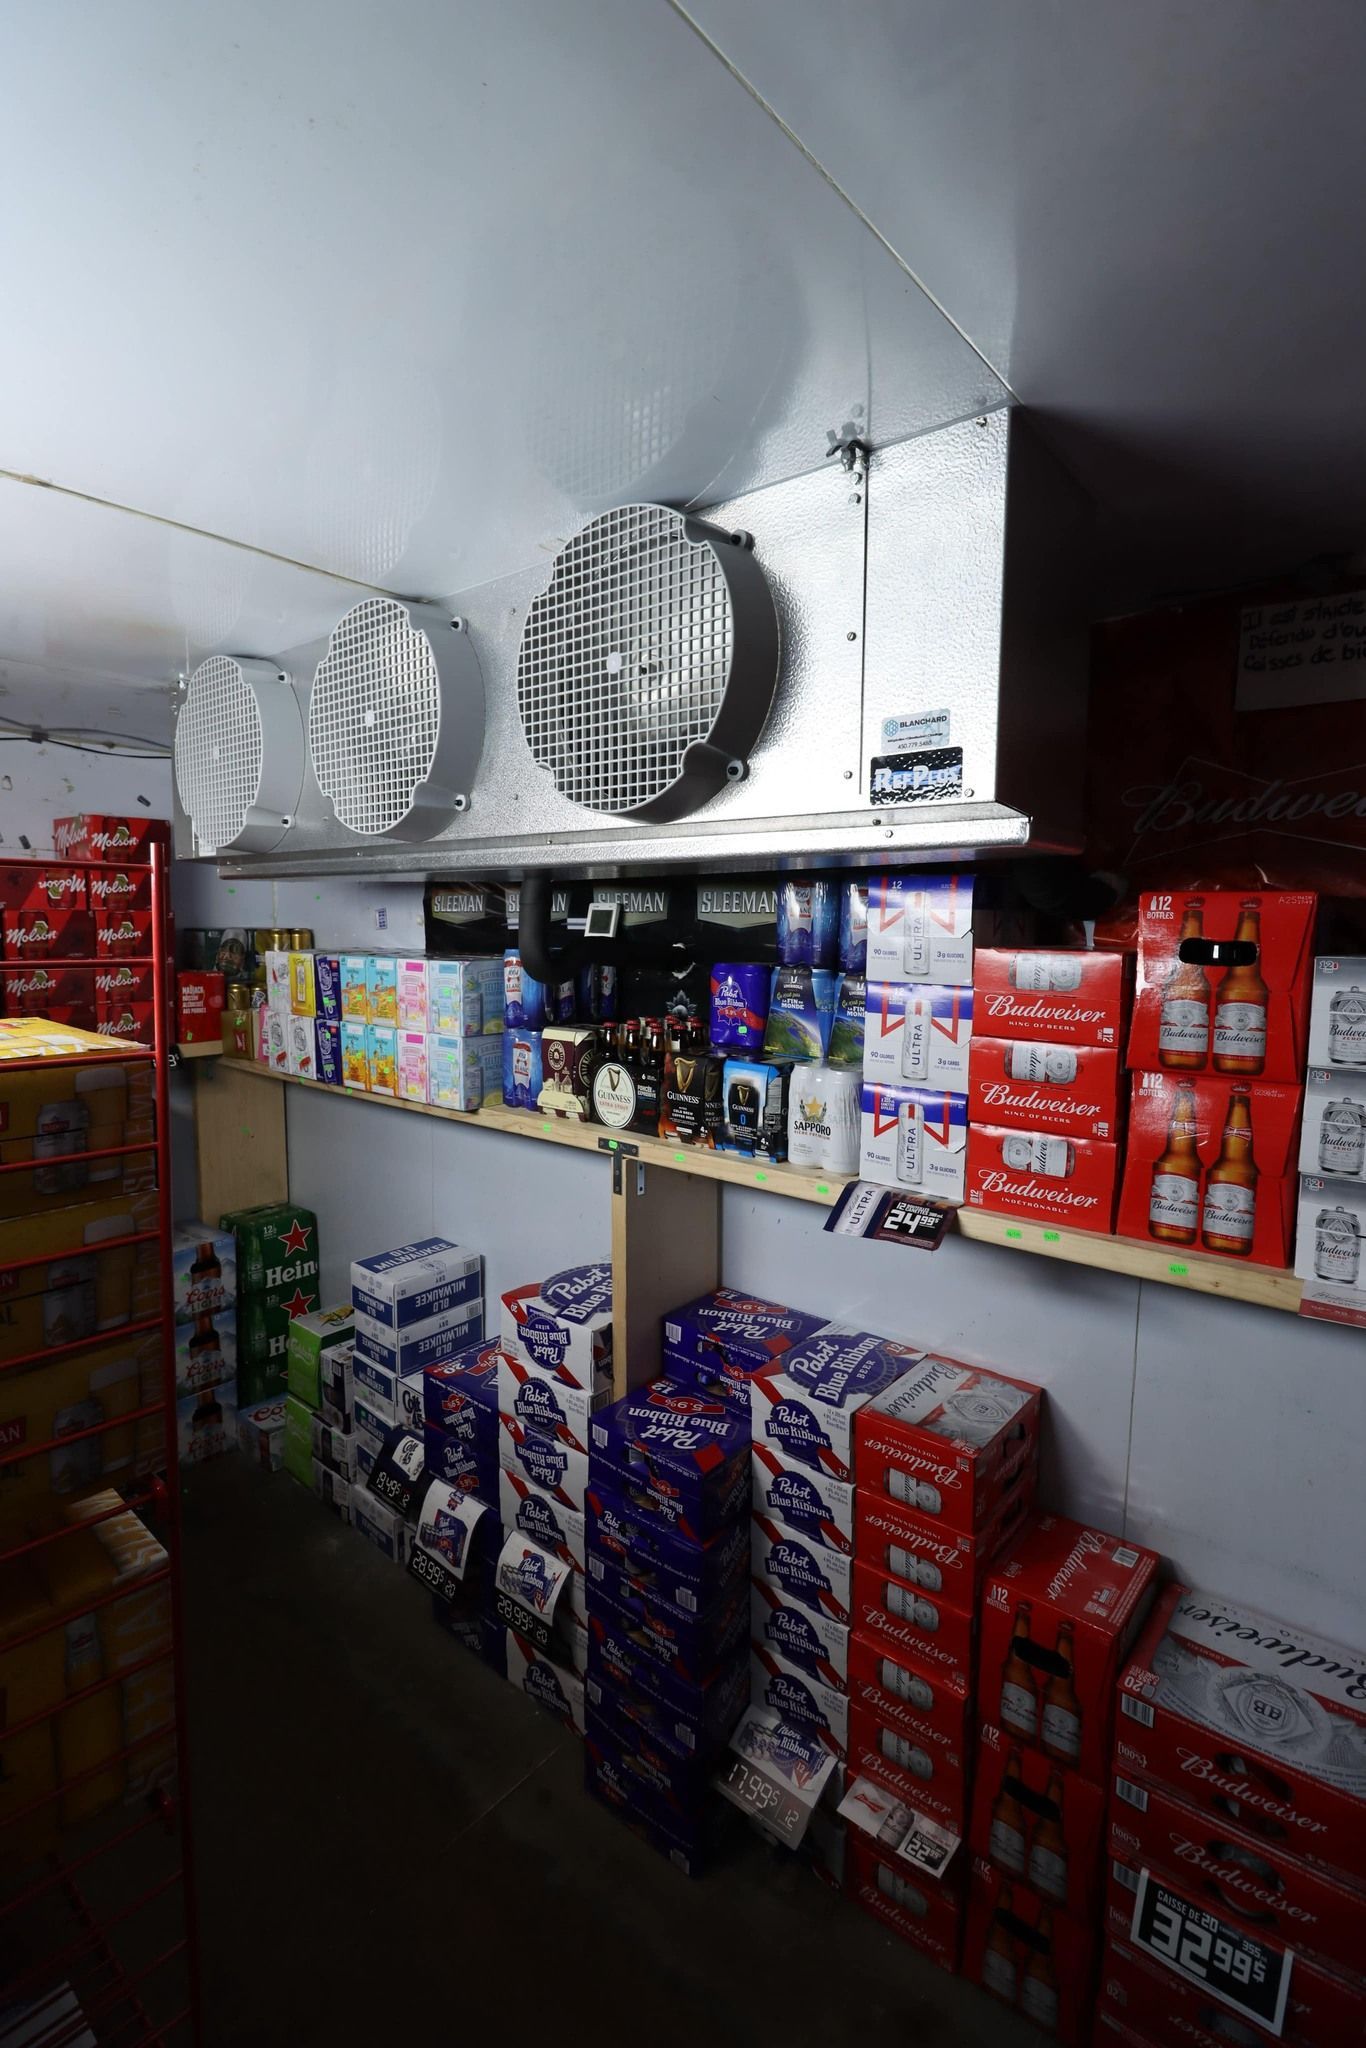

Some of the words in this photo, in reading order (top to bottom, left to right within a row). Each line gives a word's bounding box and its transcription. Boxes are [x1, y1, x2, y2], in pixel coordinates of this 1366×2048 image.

[1312, 645, 1336, 664] de
[900, 715, 947, 728] BLANCHARD
[55, 824, 88, 849] Molson
[91, 833, 139, 851] Molson
[38, 874, 86, 892] Molson
[91, 879, 136, 898] Molson
[434, 894, 484, 913] SLEEMAN
[1158, 896, 1172, 911] 12
[1147, 911, 1174, 920] BOTTLES
[6, 928, 58, 947] Molson
[97, 928, 142, 945] Molson
[913, 917, 922, 961] ULTRA
[6, 976, 56, 996] Molson
[95, 974, 141, 993] Molson
[984, 994, 1105, 1022] Budweiser
[97, 1019, 141, 1034] Molson
[1162, 1027, 1207, 1040] Budweiser
[912, 1023, 923, 1066] ULTRA
[1214, 1030, 1265, 1044] Budweiser
[1151, 1074, 1163, 1089] 12
[597, 1090, 632, 1104] GUINNESS
[667, 1090, 699, 1104] GUINNESS
[980, 1083, 1101, 1117] Budweiser
[732, 1104, 754, 1113] GUINNESS
[794, 1120, 831, 1136] SAPPORO
[1042, 1115, 1071, 1124] BEERS
[906, 1127, 916, 1169] ULTRA
[978, 1169, 1098, 1208] Budweiser
[850, 1190, 875, 1225] ULTRA
[1002, 1197, 1069, 1214] INDÉTRÔNABLE
[1152, 1200, 1197, 1216] Budweiser
[1204, 1209, 1254, 1225] Budweiser
[373, 1243, 451, 1271] MILWAUKEE
[391, 1246, 417, 1256] OLD
[415, 1278, 467, 1308] MILWAUKEE
[546, 1267, 610, 1300] Pabst
[186, 1285, 225, 1305] Coors
[433, 1298, 449, 1312] OLD
[561, 1291, 604, 1320] Blue
[698, 1309, 757, 1323] Ribbon
[761, 1314, 795, 1330] Blue
[418, 1322, 469, 1353] MILWAUKEE
[520, 1325, 549, 1345] Ribbon
[549, 1330, 570, 1345] Blue
[712, 1320, 768, 1339] Pabst
[436, 1342, 452, 1358] OLD
[534, 1344, 561, 1364] Pabst
[829, 1335, 884, 1377] Ribbon
[887, 1343, 905, 1353] 12
[789, 1340, 840, 1379] Pabst
[856, 1359, 876, 1380] BEER
[522, 1384, 550, 1404] Pabst
[815, 1370, 849, 1402] Blue
[886, 1363, 962, 1417] Budweiser
[517, 1401, 533, 1414] Blue
[533, 1404, 565, 1424] Ribbon
[665, 1398, 705, 1411] 5.9%
[627, 1407, 686, 1427] Ribbon
[776, 1405, 810, 1427] Pabst
[640, 1425, 702, 1450] Pabst
[690, 1418, 731, 1437] Blue
[768, 1422, 790, 1436] Blue
[790, 1425, 828, 1447] Ribbon
[403, 1440, 418, 1453] Colt
[864, 1438, 962, 1490] Budweiser
[531, 1464, 558, 1486] Pabst
[776, 1477, 811, 1500] Pabst
[523, 1500, 550, 1523] Pabst
[769, 1494, 792, 1508] Blue
[792, 1497, 831, 1520] Ribbon
[518, 1515, 535, 1529] Blue
[534, 1519, 565, 1542] Ribbon
[864, 1514, 964, 1569] Budweiser
[775, 1545, 810, 1569] Pabst
[1046, 1530, 1107, 1601] Budweiser
[768, 1559, 791, 1576] Blue
[791, 1565, 829, 1590] Ribbon
[999, 1587, 1009, 1604] 12
[774, 1611, 809, 1637] Pabst
[768, 1625, 790, 1642] Blue
[789, 1632, 827, 1658] Ribbon
[862, 1604, 959, 1665] Budweiser
[773, 1677, 807, 1704] Pabst
[791, 1698, 828, 1727] Ribbon
[857, 1680, 952, 1744] Budweiser
[987, 1726, 999, 1743] 12
[857, 1746, 952, 1815] Budweiser
[1175, 1746, 1328, 1834] Budweiser
[785, 1809, 800, 1828] 12
[1169, 1832, 1320, 1925] Budweiser
[1157, 1890, 1187, 1915] CAISSE
[1189, 1908, 1201, 1923] DE
[1201, 1911, 1219, 1934] 20
[1242, 1940, 1261, 1957] 355
